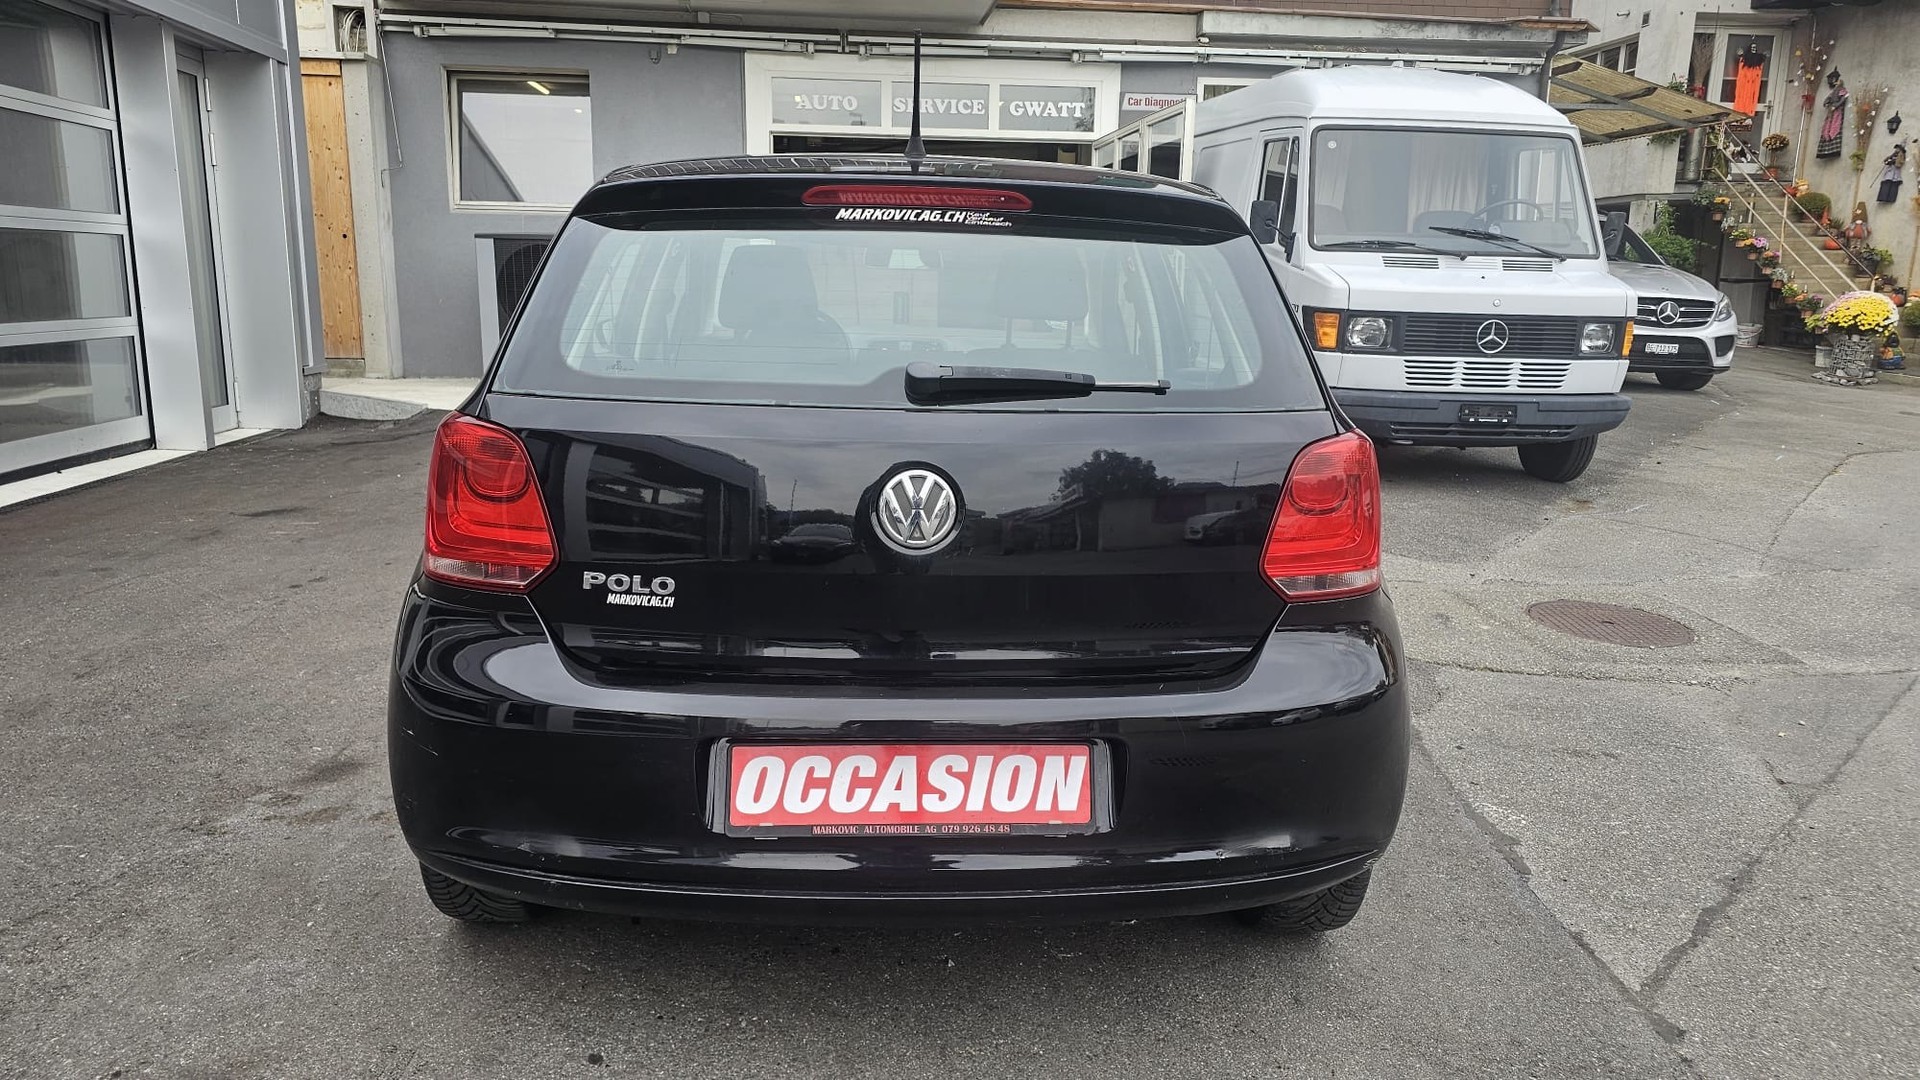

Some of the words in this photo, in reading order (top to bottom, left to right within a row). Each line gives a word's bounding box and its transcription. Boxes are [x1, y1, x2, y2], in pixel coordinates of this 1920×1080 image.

[796, 95, 858, 111] AUTO
[1009, 101, 1086, 118] GWATT
[1127, 97, 1143, 107] Car
[1144, 97, 1184, 109] Diagno
[834, 208, 966, 223] MARKOVICAG.CH
[583, 571, 676, 595] POLO
[606, 593, 675, 607] MARKOVICAG.CH
[735, 754, 1087, 814] OCCASION
[812, 825, 859, 834] MARKOVIC
[863, 825, 920, 834] AUTOMOBILE
[924, 825, 937, 833] AG
[942, 825, 960, 833] 079
[962, 825, 981, 833] 926
[984, 825, 996, 833] 48
[998, 825, 1010, 833] 48
